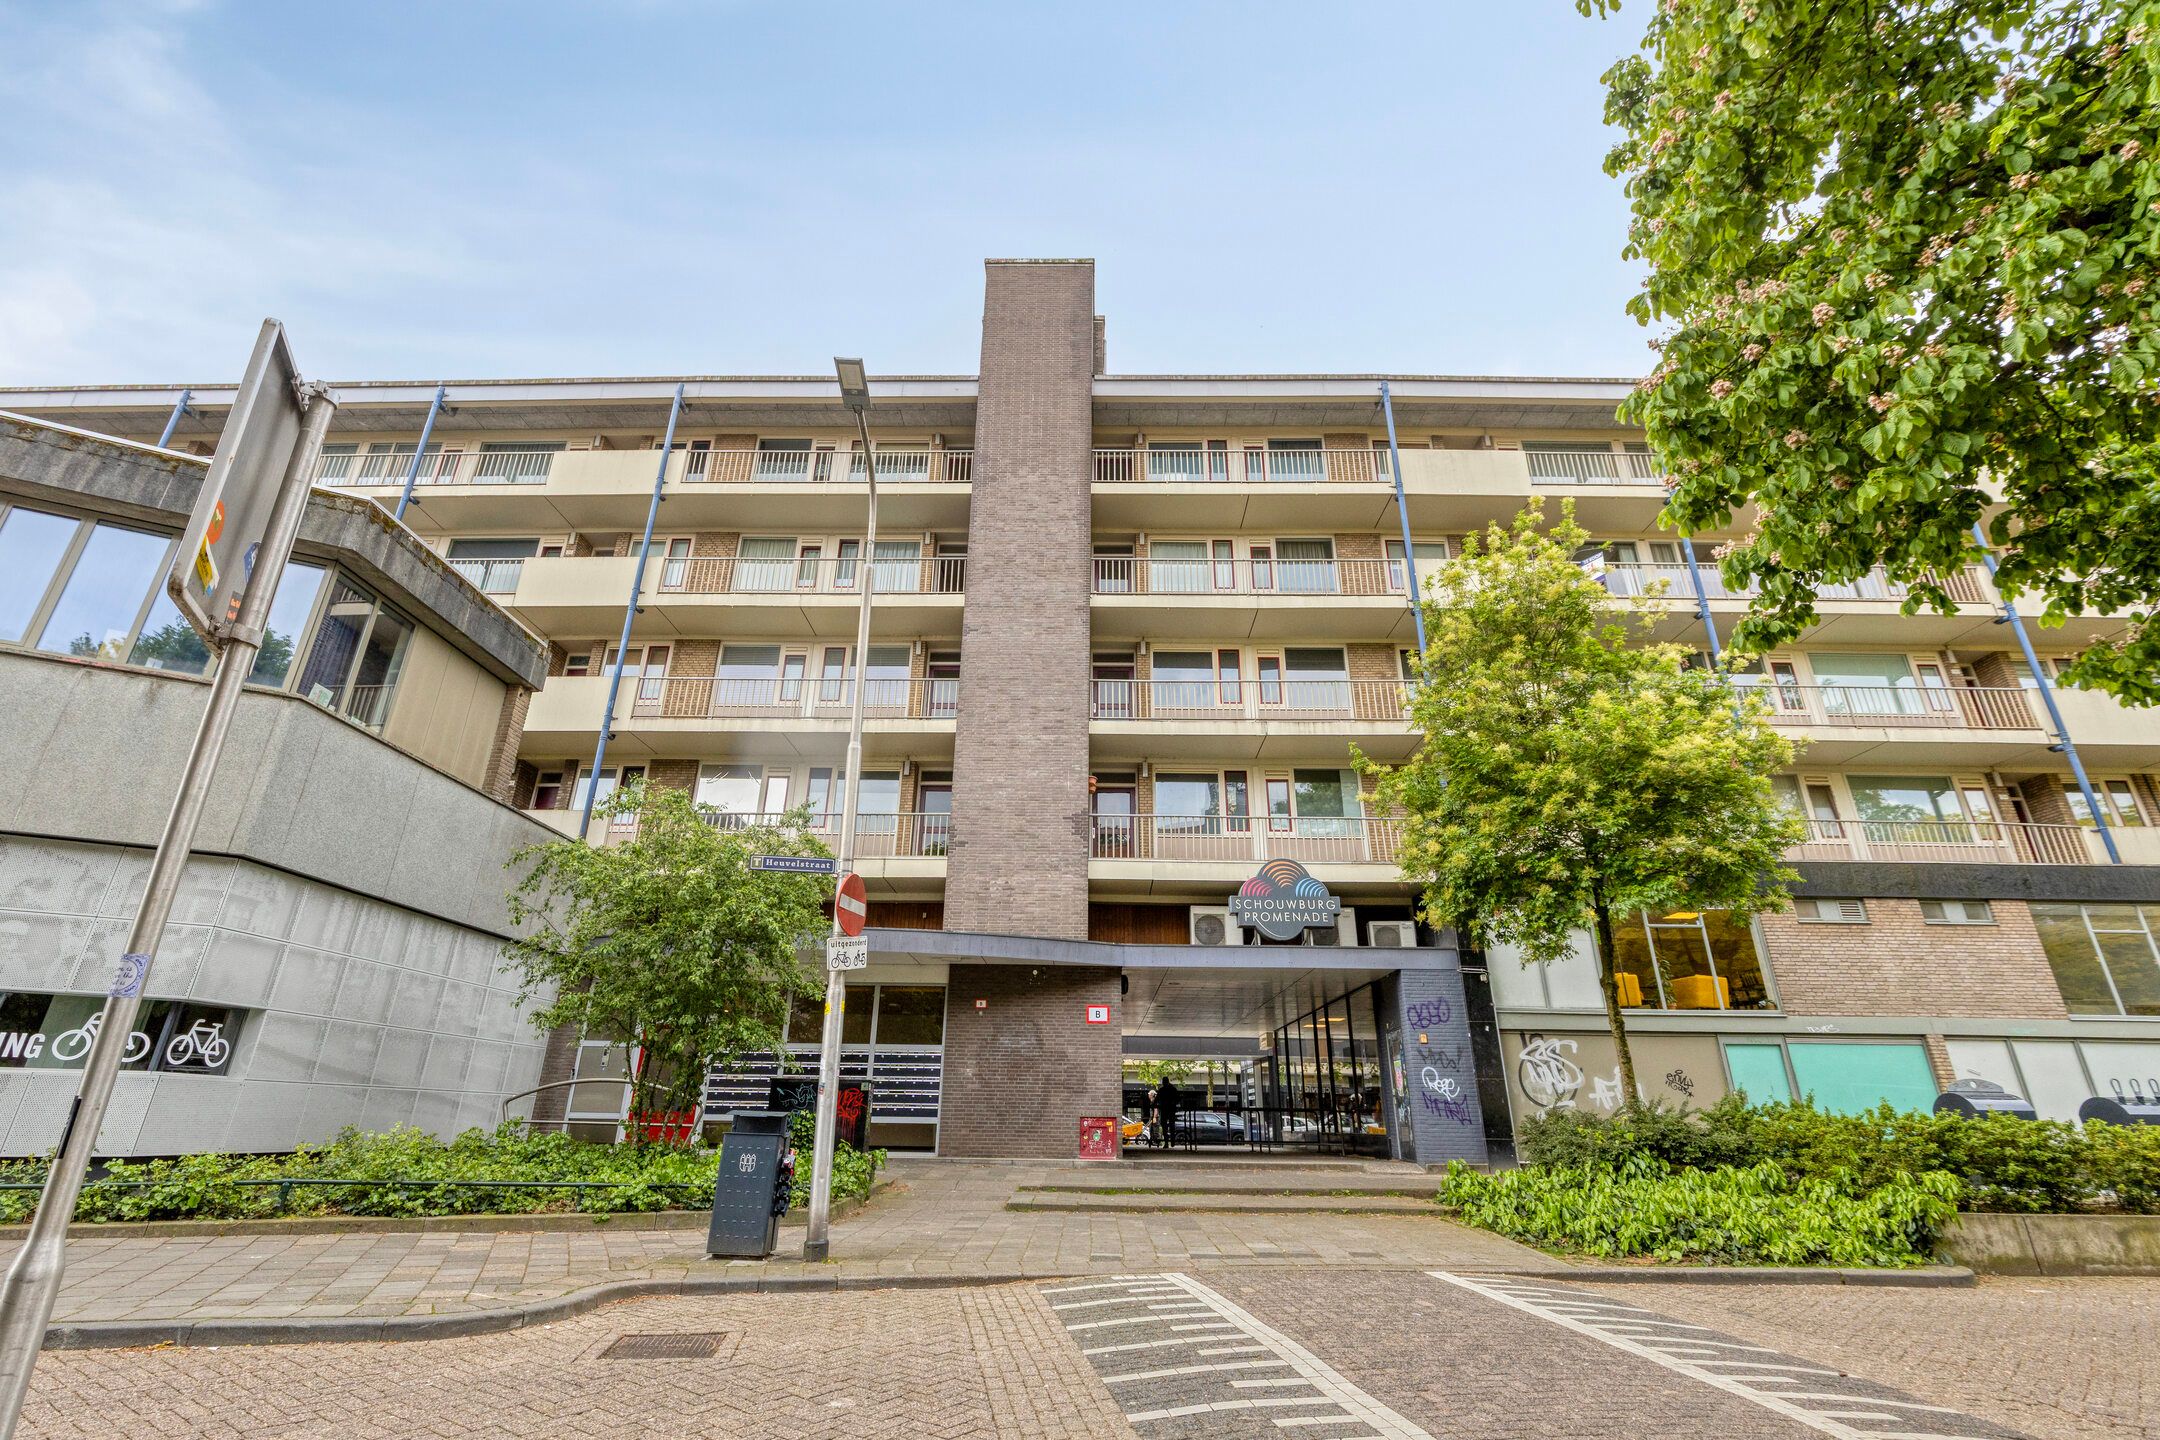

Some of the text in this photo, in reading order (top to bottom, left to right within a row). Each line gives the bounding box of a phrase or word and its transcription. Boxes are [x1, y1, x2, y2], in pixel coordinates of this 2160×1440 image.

[766, 859, 831, 869] Heuvelstraat
[1235, 899, 1336, 910] SCHOUWBURG
[1244, 912, 1329, 922] PROMENADE
[830, 939, 867, 949] uitgezonderd
